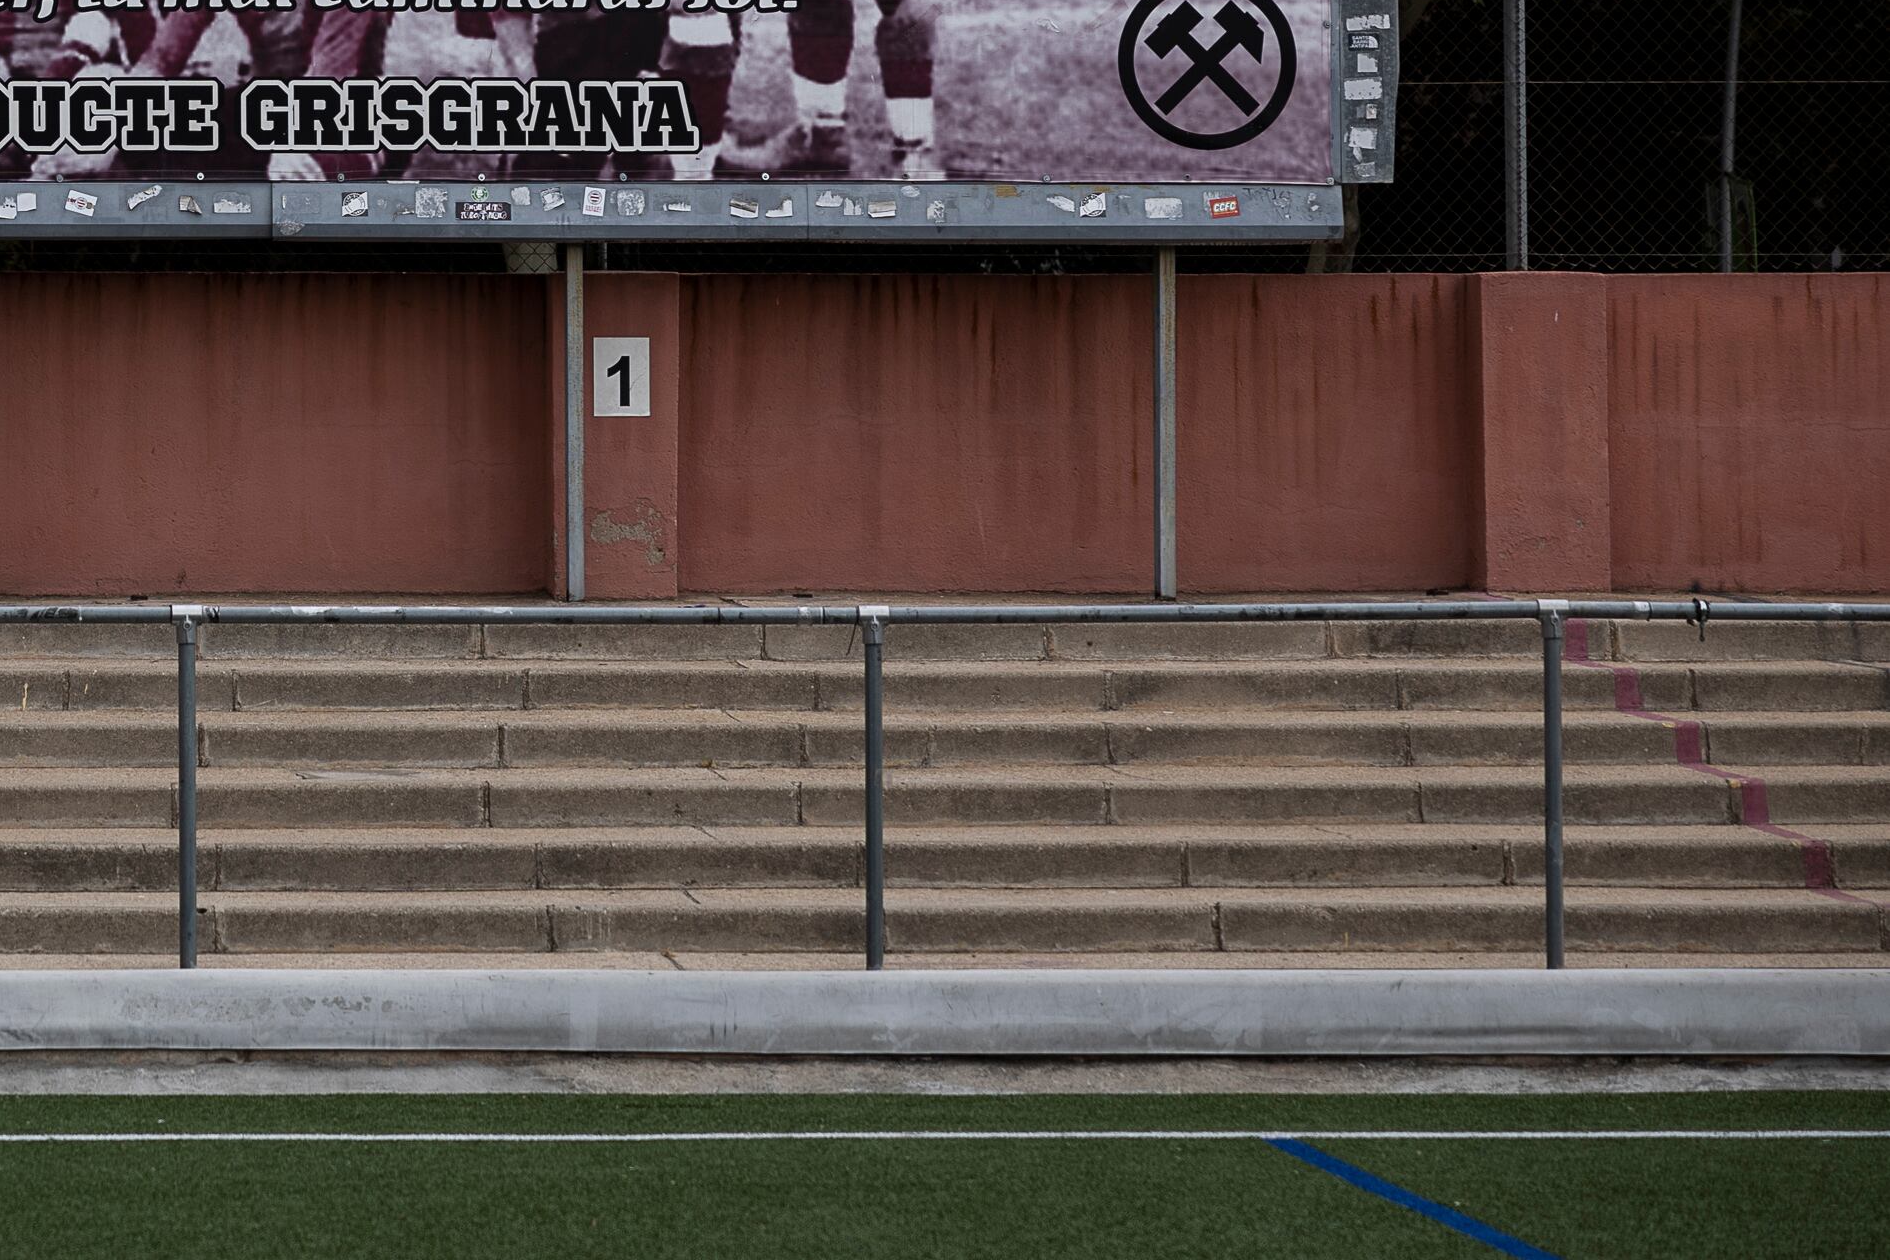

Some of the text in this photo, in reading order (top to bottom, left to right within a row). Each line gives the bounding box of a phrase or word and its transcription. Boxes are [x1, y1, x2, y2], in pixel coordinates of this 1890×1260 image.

[241, 80, 700, 152] GRISGRANA
[1213, 201, 1238, 213] CCFC
[606, 355, 631, 407] 1
